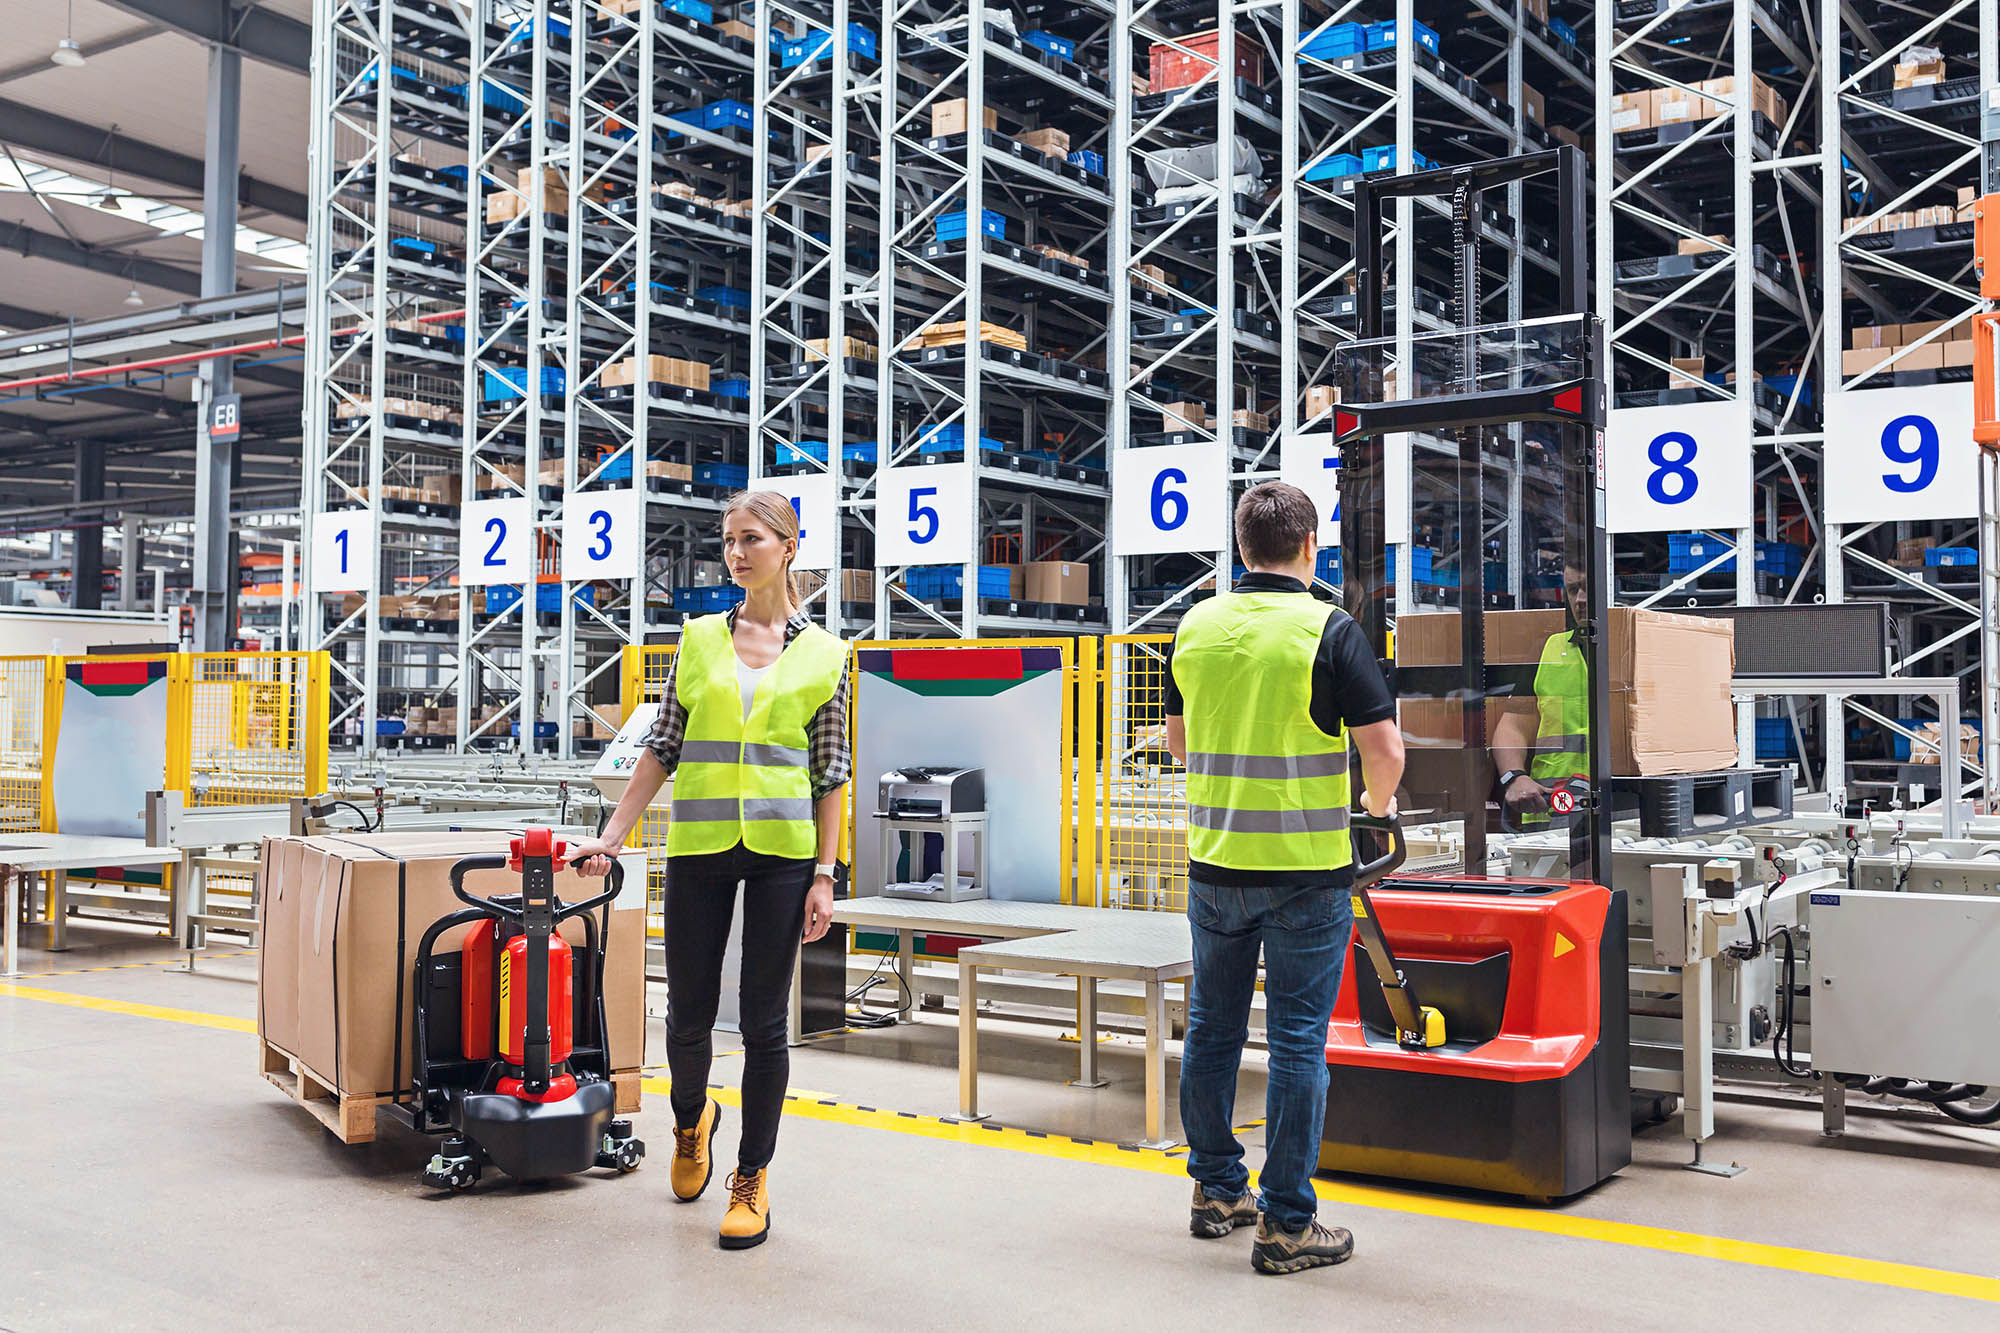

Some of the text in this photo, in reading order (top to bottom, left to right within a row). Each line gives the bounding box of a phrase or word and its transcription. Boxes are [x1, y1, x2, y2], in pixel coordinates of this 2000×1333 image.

[215, 403, 236, 429] E8
[1646, 431, 1699, 505] 8
[1880, 414, 1940, 493] 9
[907, 486, 940, 545] 5
[1150, 467, 1189, 532] 6
[335, 529, 349, 574] 1
[483, 517, 507, 567] 2
[587, 509, 613, 561] 3
